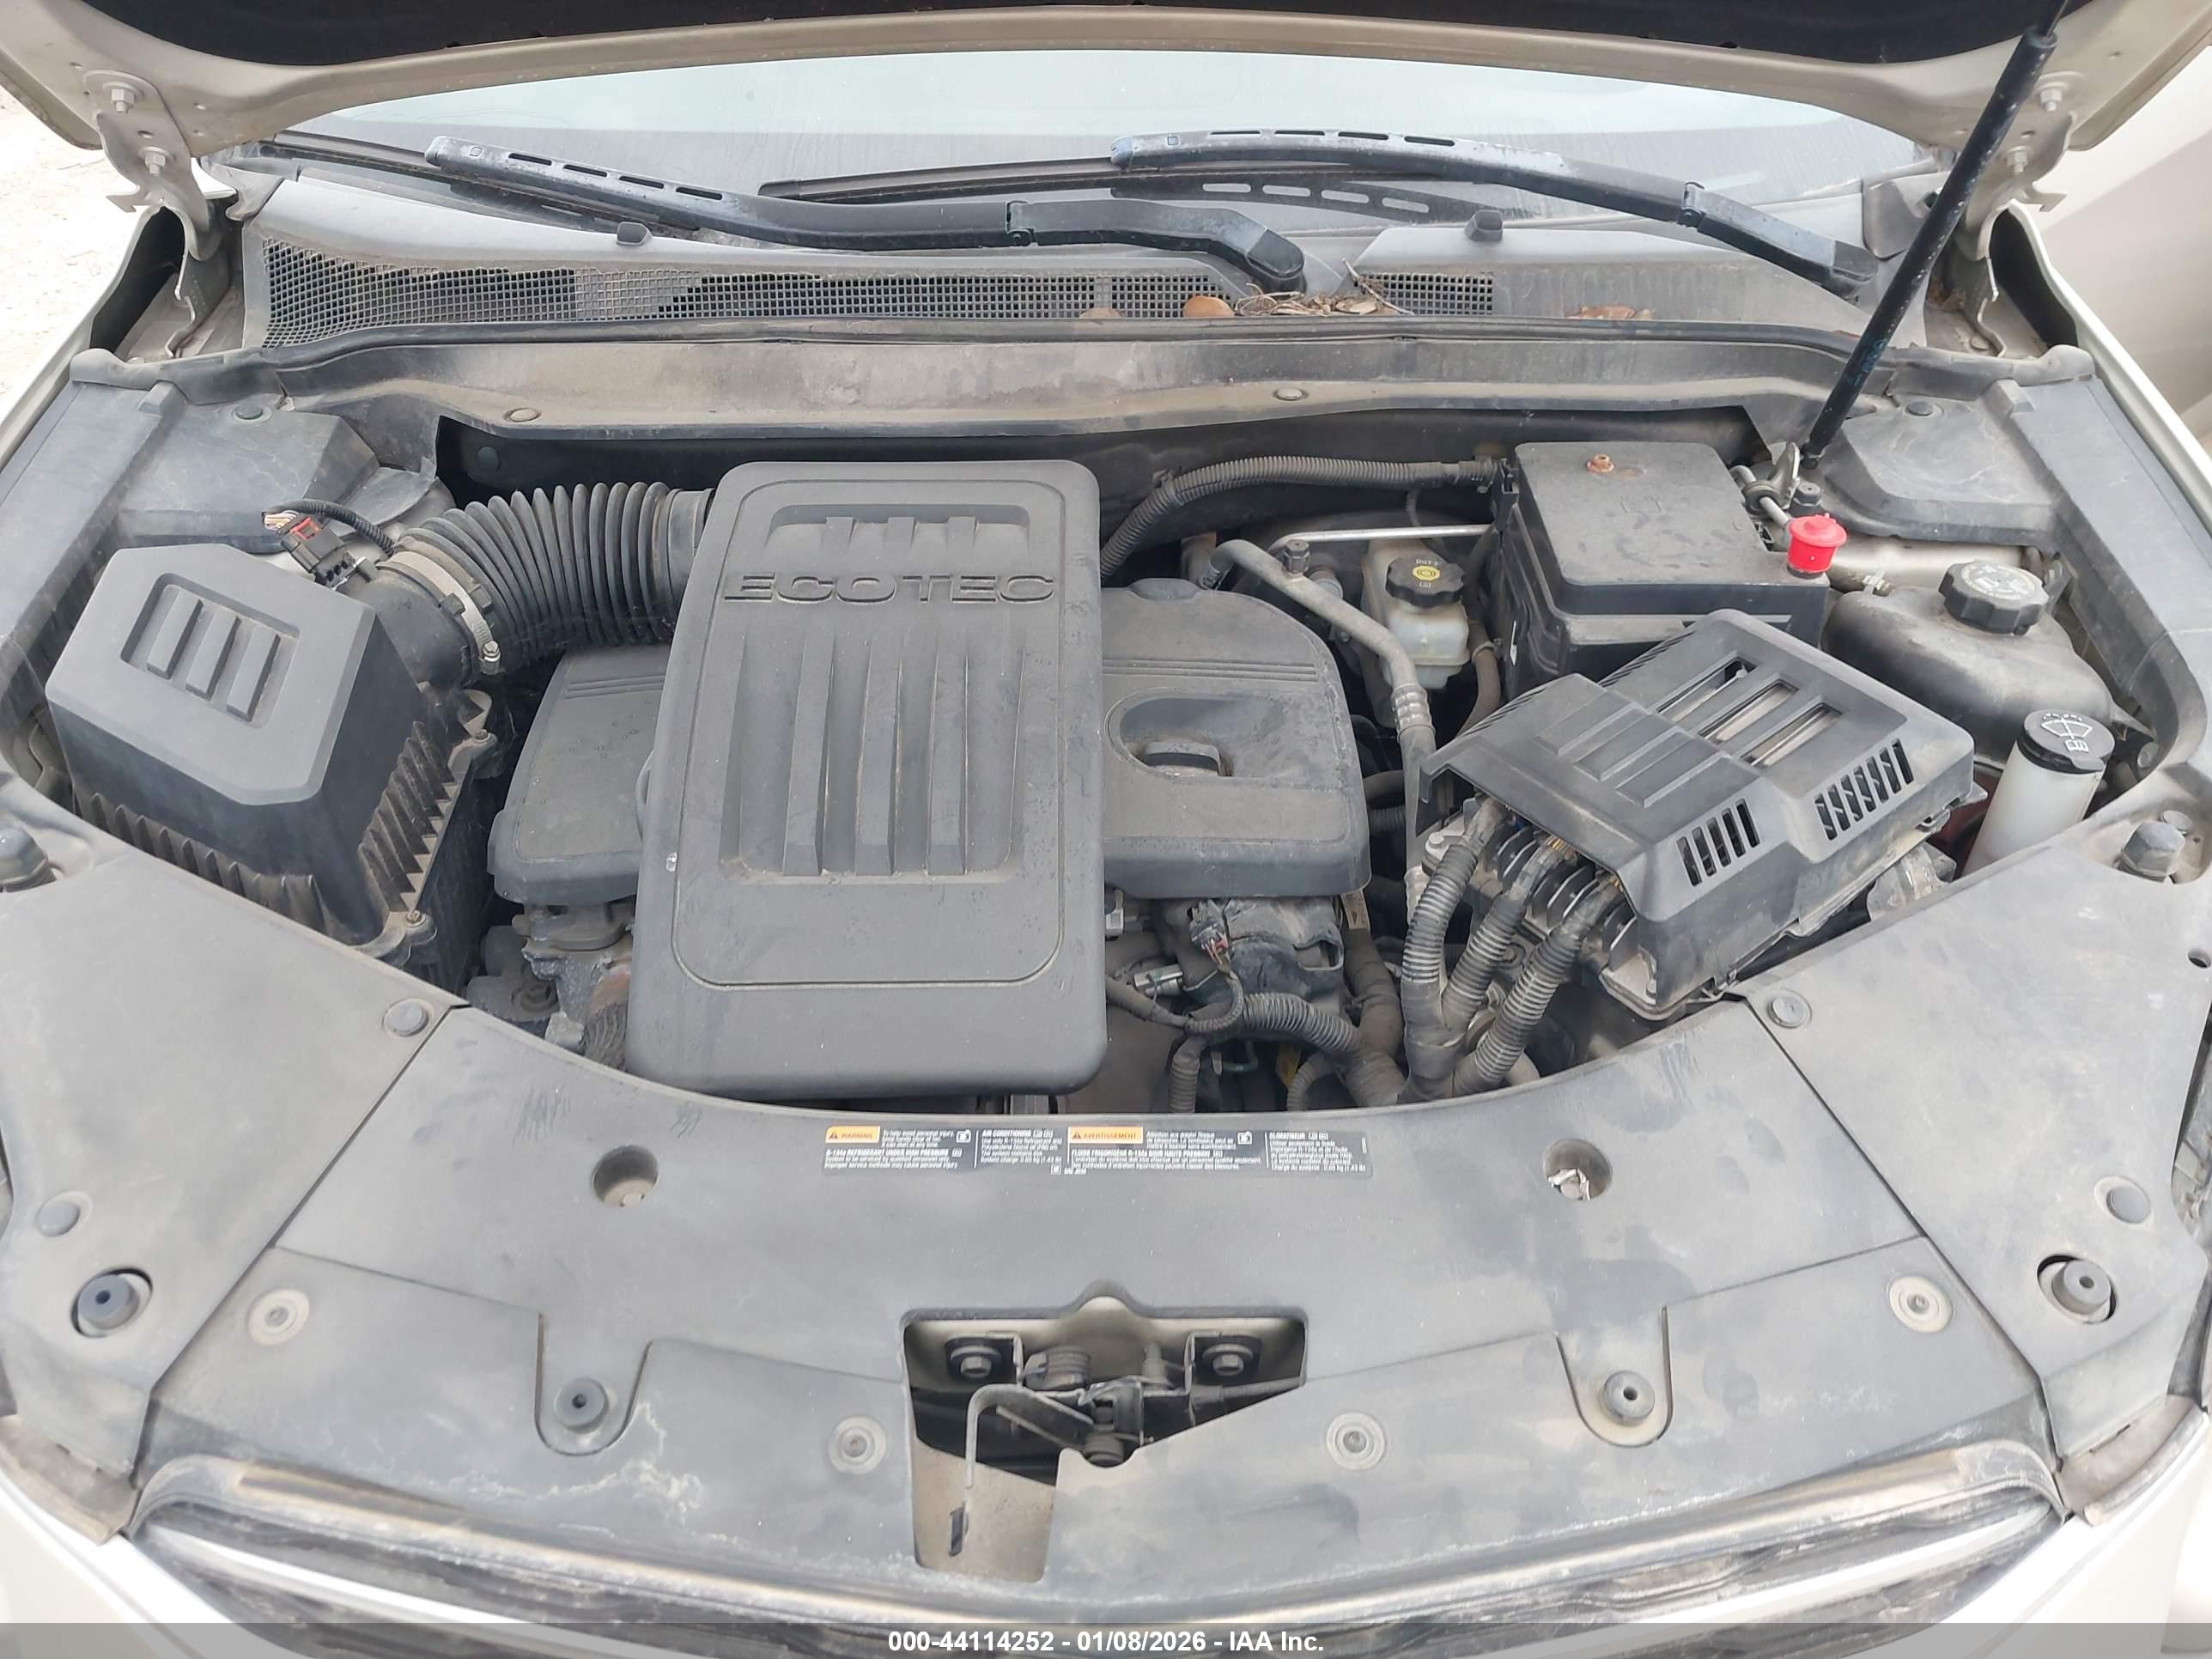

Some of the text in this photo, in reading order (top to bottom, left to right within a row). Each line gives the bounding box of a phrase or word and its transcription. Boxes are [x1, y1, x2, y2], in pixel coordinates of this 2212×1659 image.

[724, 574, 1055, 603] ECOTEC
[981, 1129, 1031, 1138] AIR CONDITIONING
[1269, 1132, 1306, 1140] CLIMATISEUR
[1182, 1148, 1210, 1158] PRESSION
